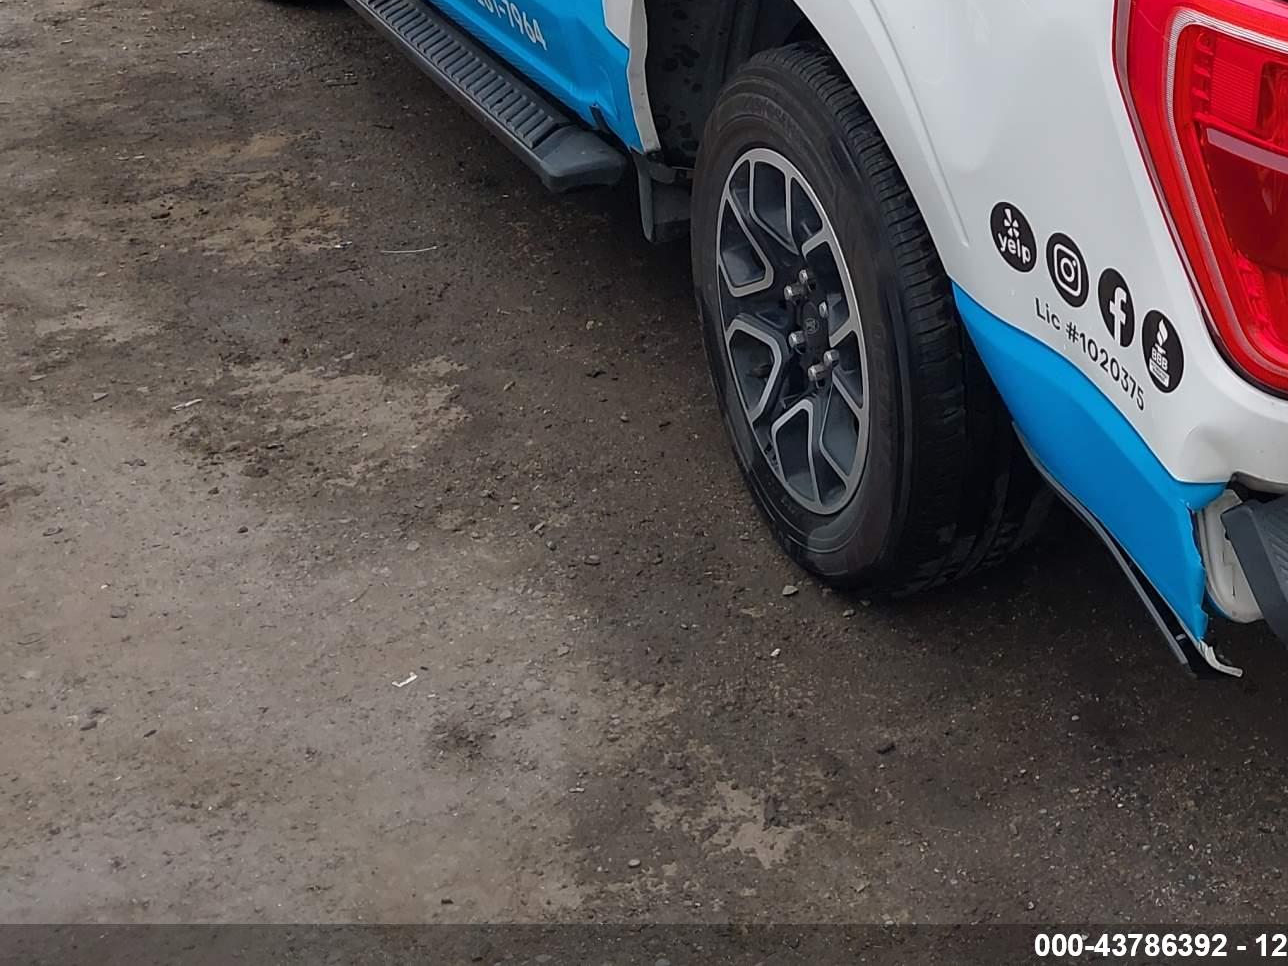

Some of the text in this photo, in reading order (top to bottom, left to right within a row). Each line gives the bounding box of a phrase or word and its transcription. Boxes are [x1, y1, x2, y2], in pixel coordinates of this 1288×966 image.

[998, 232, 1031, 264] yelp
[1035, 297, 1144, 411] Lic #1020375
[1151, 347, 1169, 371] BBB
